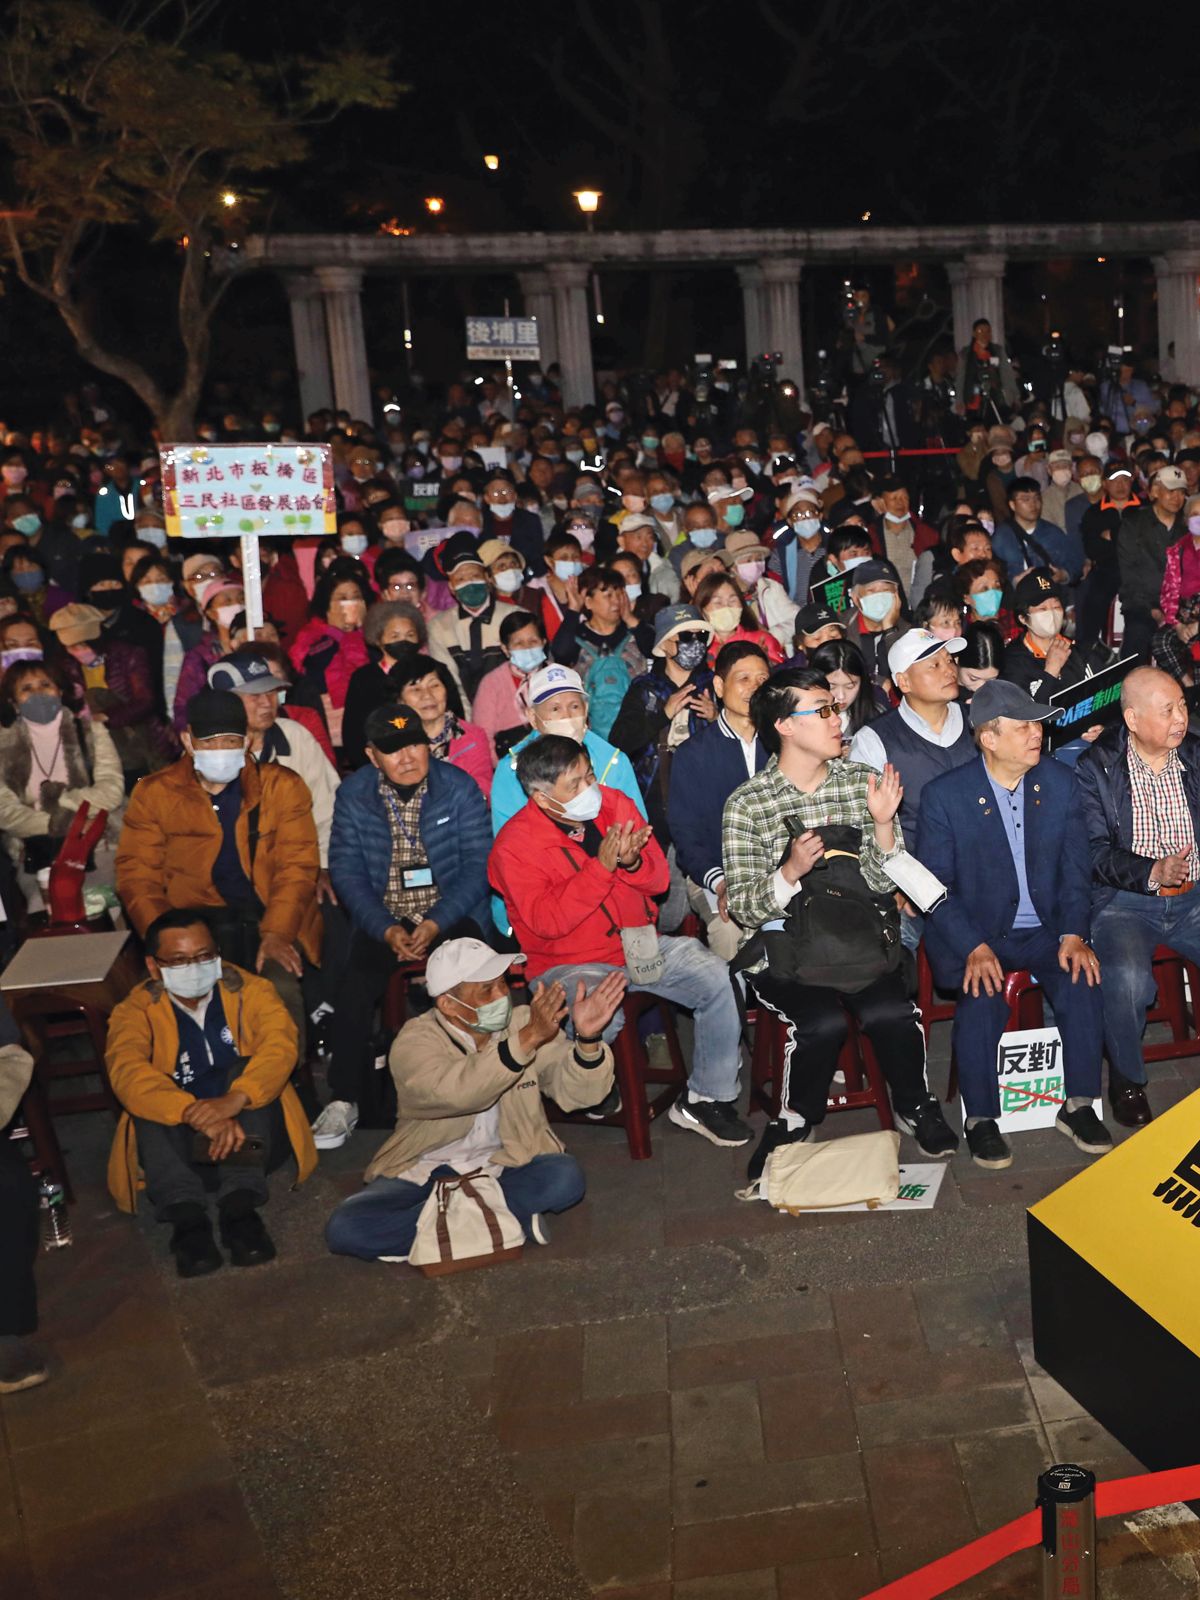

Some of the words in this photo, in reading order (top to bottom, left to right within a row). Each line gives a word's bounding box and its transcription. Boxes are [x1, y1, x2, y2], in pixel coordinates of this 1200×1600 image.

[467, 321, 538, 344] 後埔里
[181, 460, 318, 484] 新北市板橋區
[1036, 576, 1052, 590] LA
[998, 1039, 1061, 1076] 反對
[1000, 1076, 1066, 1112] 色恐
[1061, 1510, 1080, 1596] 海山分局
